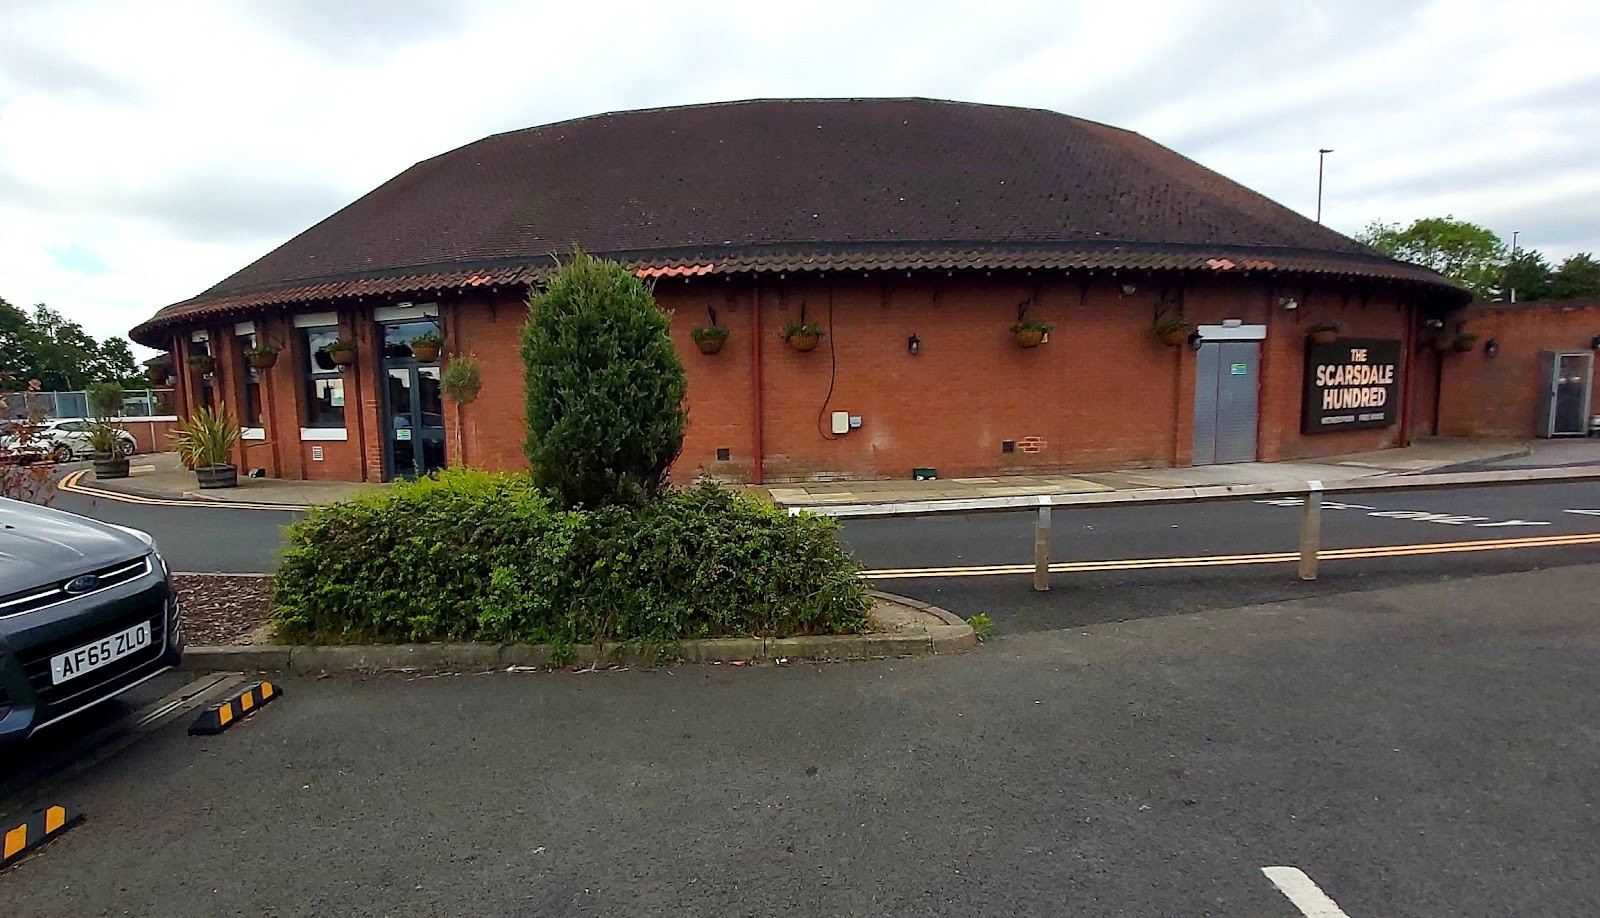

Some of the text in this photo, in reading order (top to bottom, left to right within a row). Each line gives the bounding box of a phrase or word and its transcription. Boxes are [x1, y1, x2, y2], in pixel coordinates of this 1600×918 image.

[1350, 348, 1368, 362] THE
[1316, 364, 1394, 387] SCARSDALE
[1322, 387, 1386, 410] HUNDRED
[63, 626, 145, 678] AF65 ZLO
